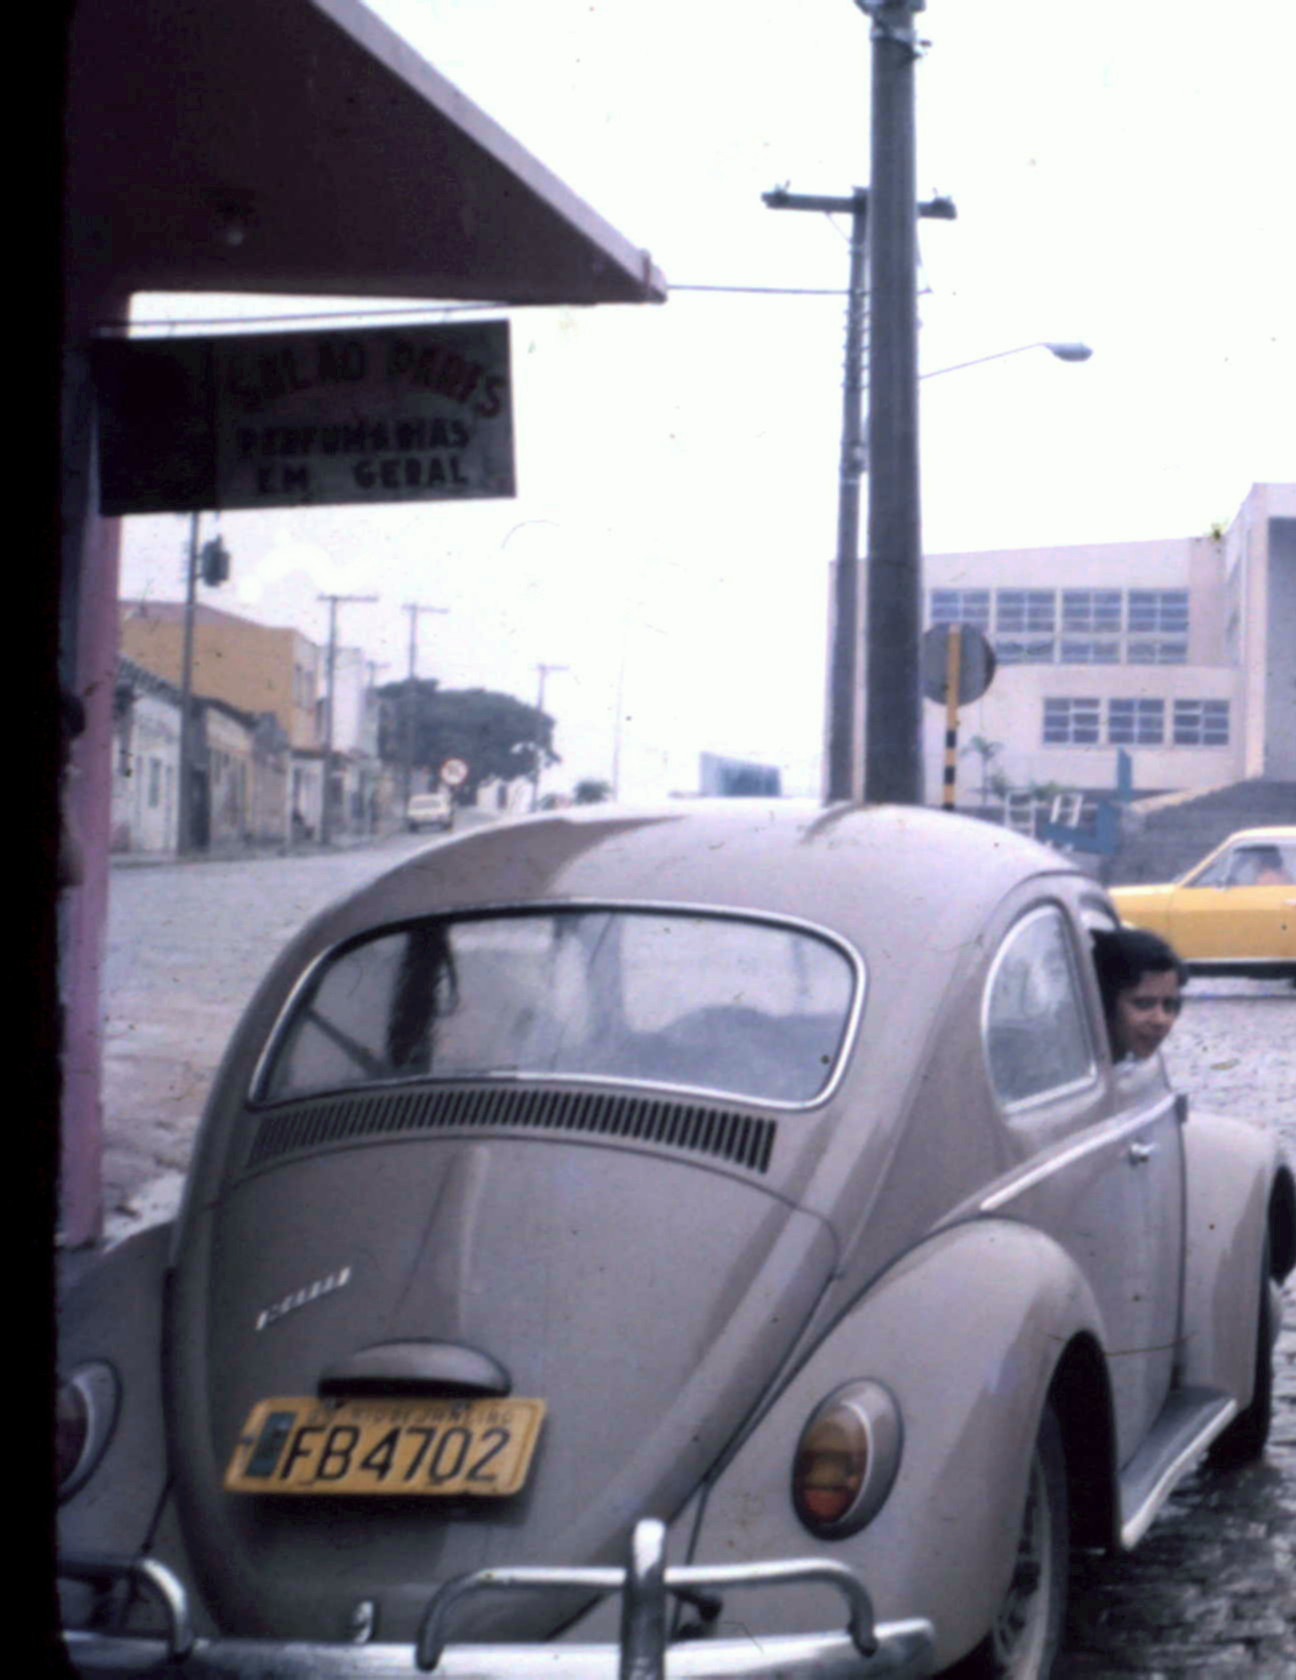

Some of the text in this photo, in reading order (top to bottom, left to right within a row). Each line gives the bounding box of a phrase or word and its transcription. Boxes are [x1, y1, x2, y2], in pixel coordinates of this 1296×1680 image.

[236, 418, 471, 457] PERFUMARIAS
[257, 455, 469, 494] EM GERAL
[279, 1425, 511, 1483] FB4702
